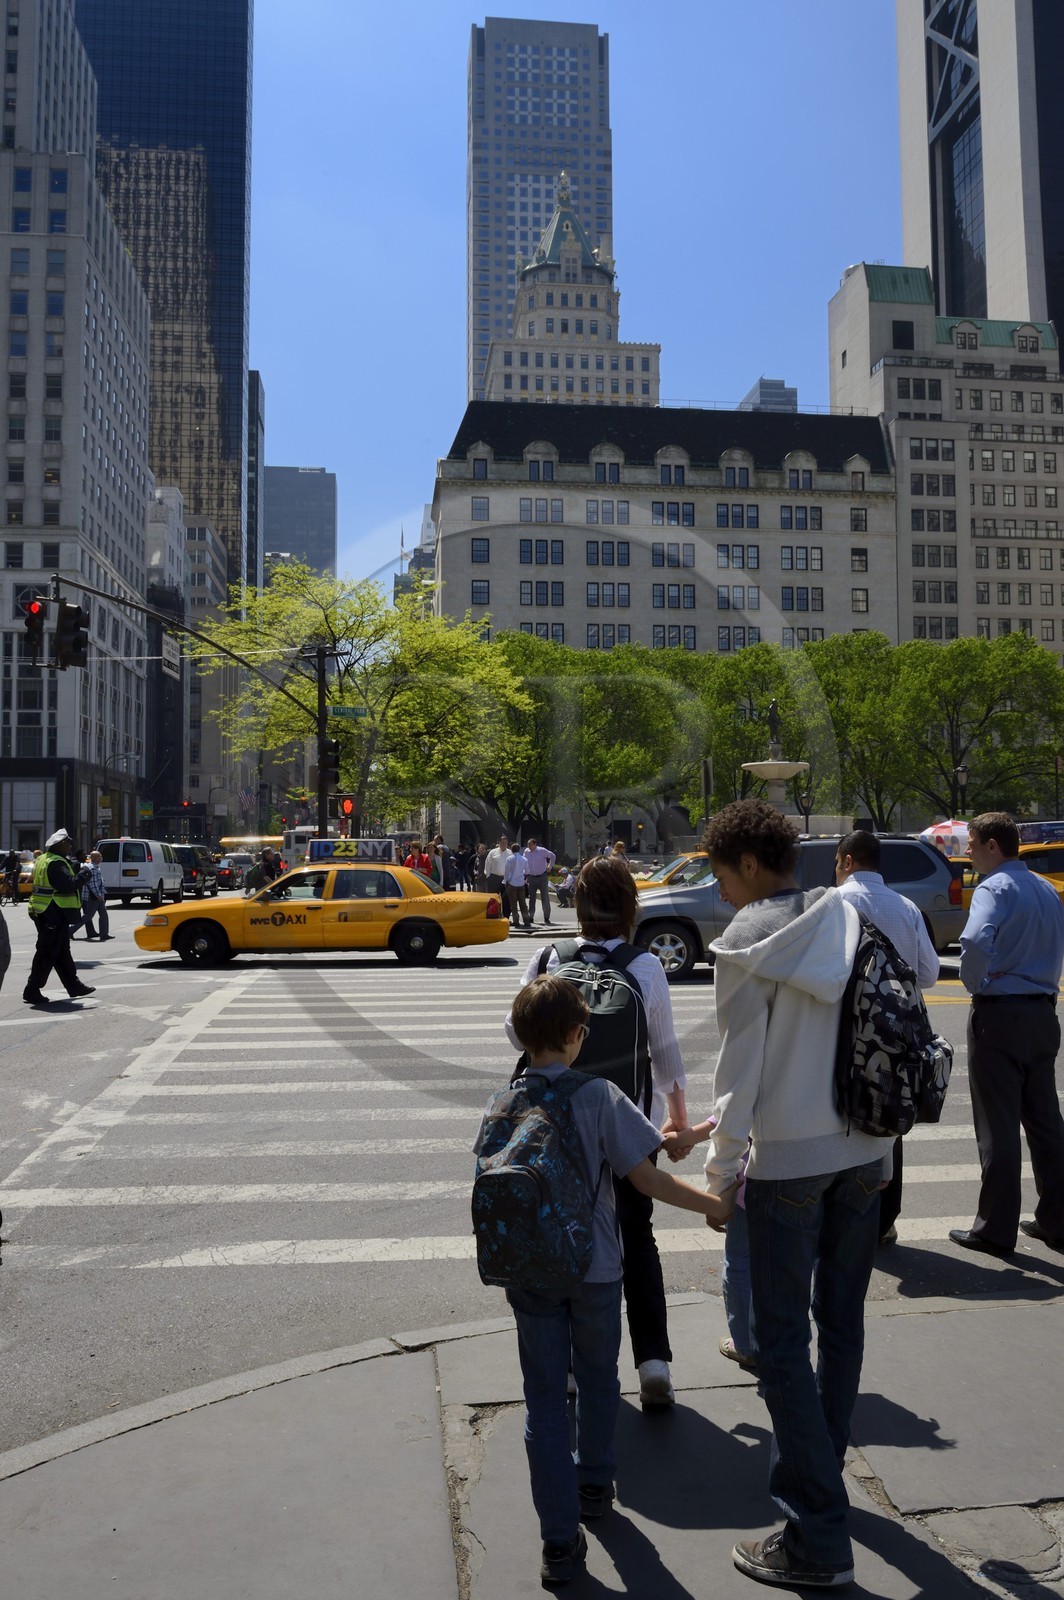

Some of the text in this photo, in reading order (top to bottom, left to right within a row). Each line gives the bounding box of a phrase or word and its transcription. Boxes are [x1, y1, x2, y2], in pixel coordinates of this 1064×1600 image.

[313, 841, 388, 857] ID23NY
[250, 911, 306, 927] NYC TAXI
